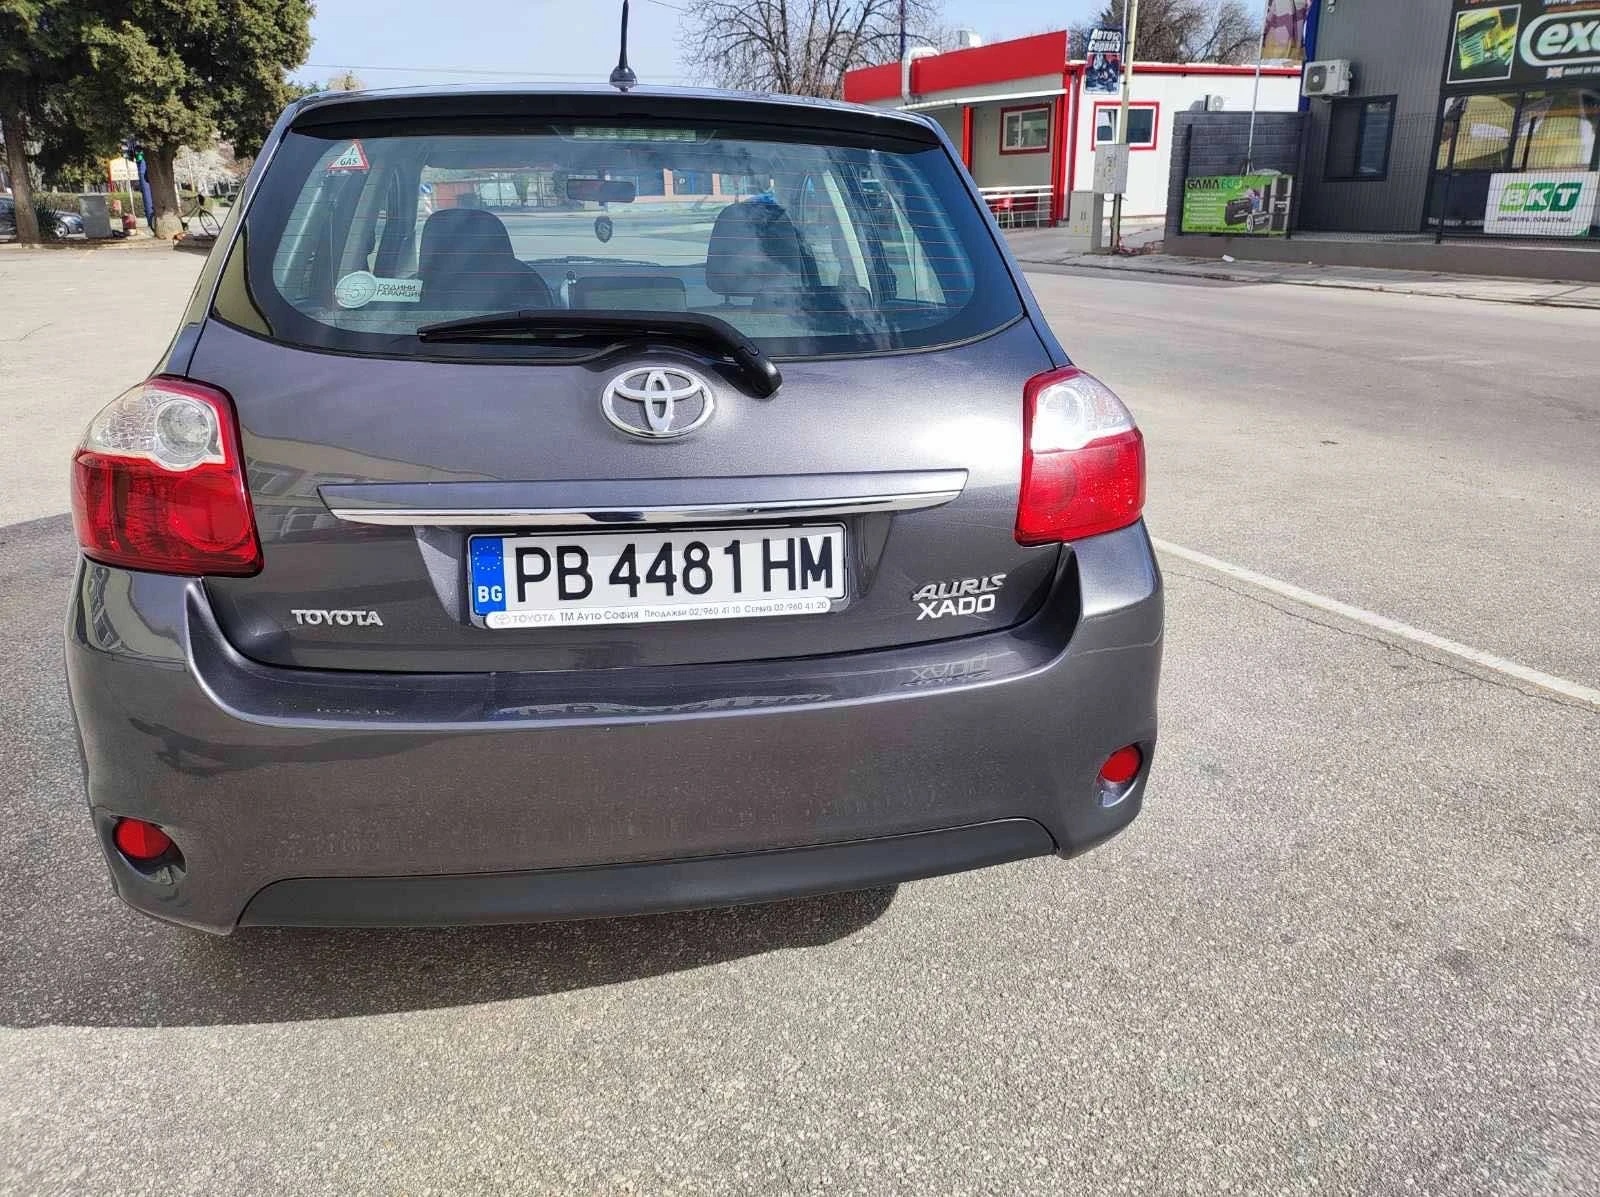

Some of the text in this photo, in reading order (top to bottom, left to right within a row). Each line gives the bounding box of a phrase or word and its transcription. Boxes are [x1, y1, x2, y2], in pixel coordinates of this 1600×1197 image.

[340, 158, 359, 166] GAS
[1502, 186, 1580, 208] BKT
[609, 539, 742, 598] 4481
[477, 585, 503, 603] BG
[912, 574, 1007, 601] AURIS
[916, 594, 996, 620] XADO
[291, 609, 384, 626] TOYOTA
[513, 613, 556, 624] TOYOTA
